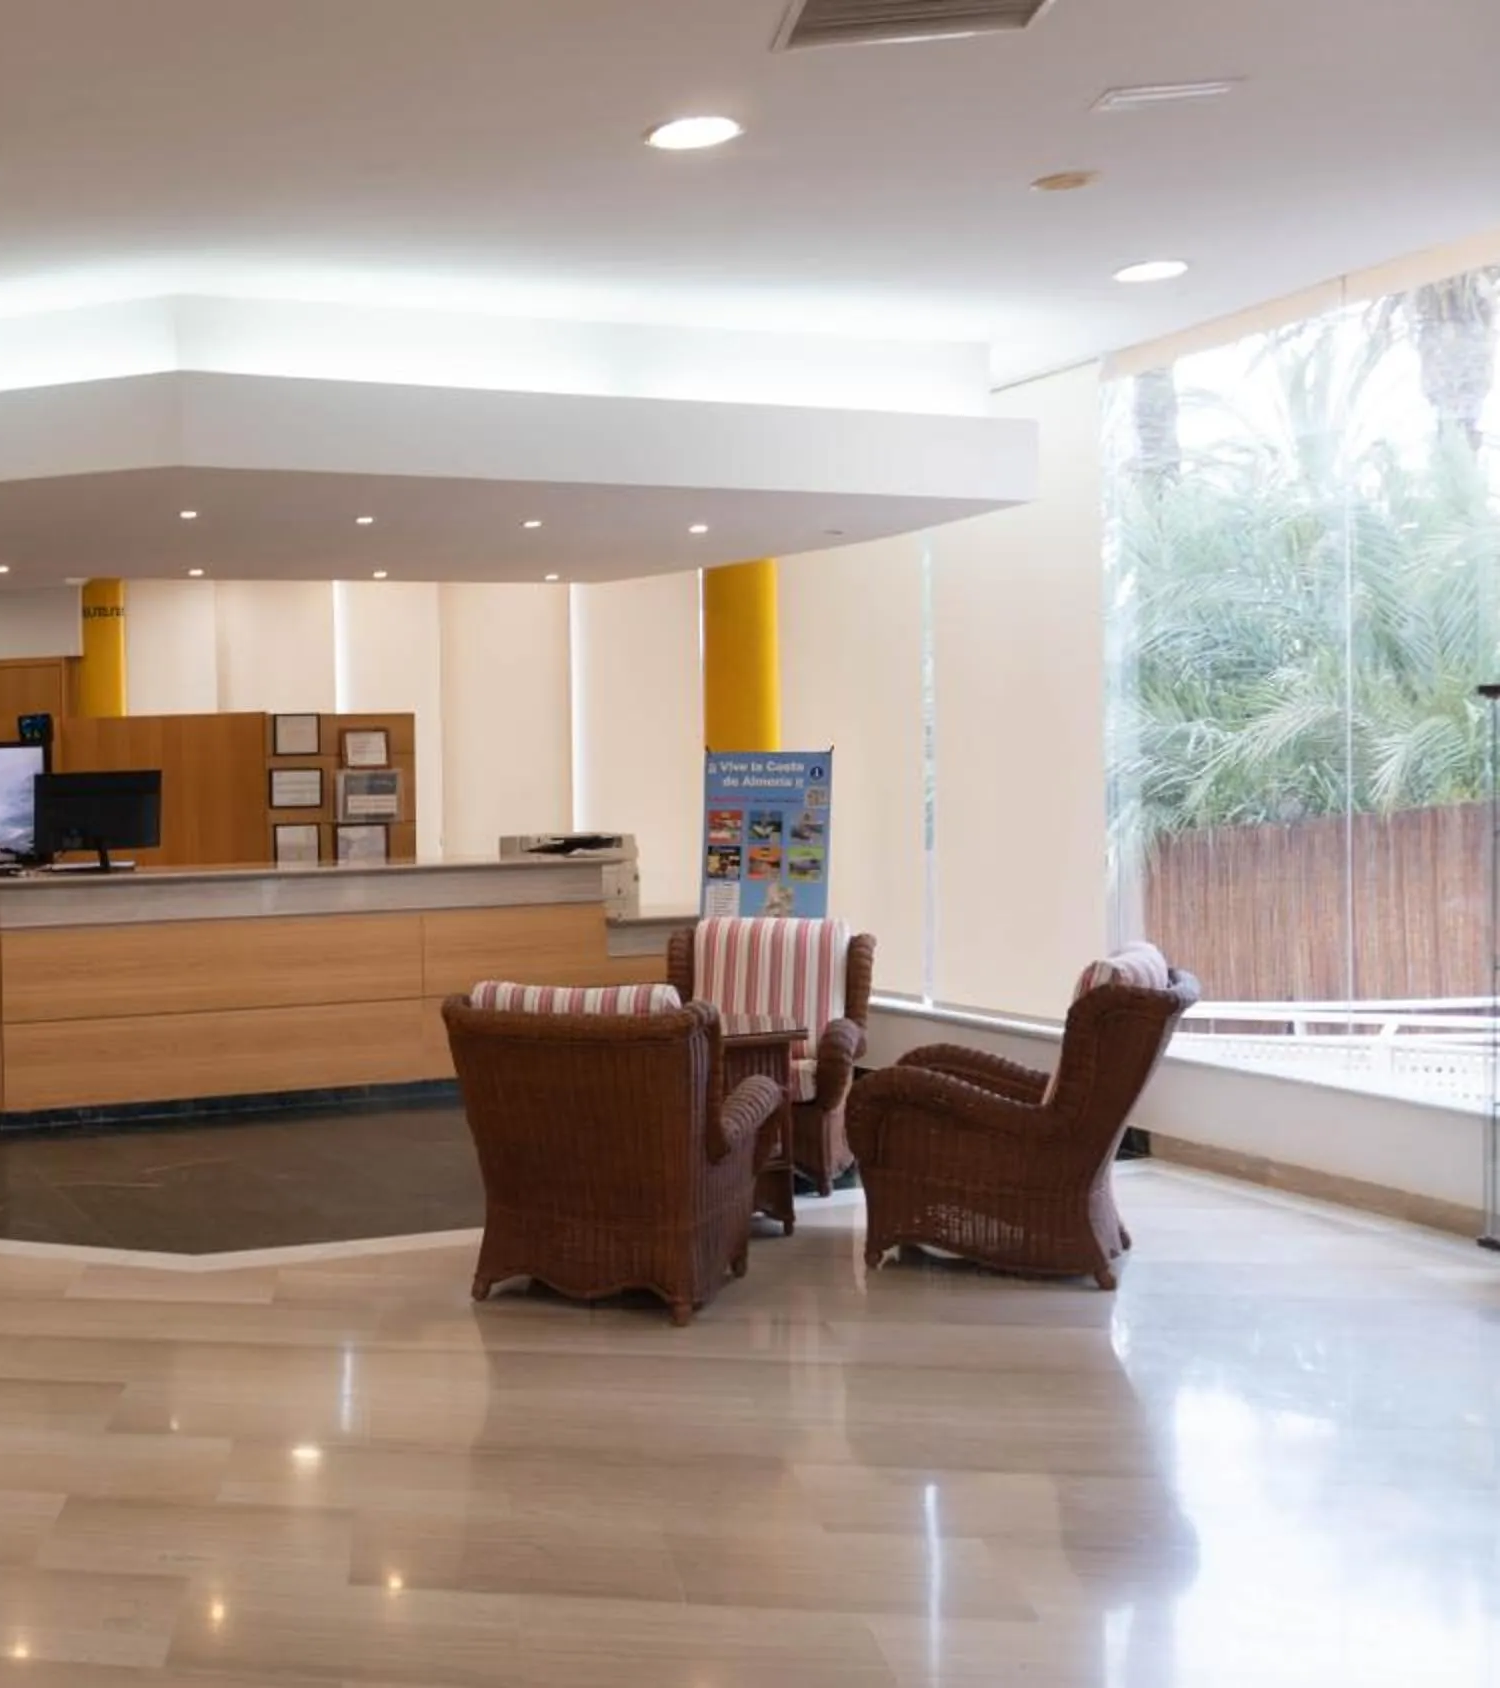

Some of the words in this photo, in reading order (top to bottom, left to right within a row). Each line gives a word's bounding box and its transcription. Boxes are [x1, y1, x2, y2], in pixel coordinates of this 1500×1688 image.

[719, 761, 748, 772] Vive
[751, 761, 764, 772] la
[766, 761, 805, 772] Costa
[723, 776, 739, 787] de
